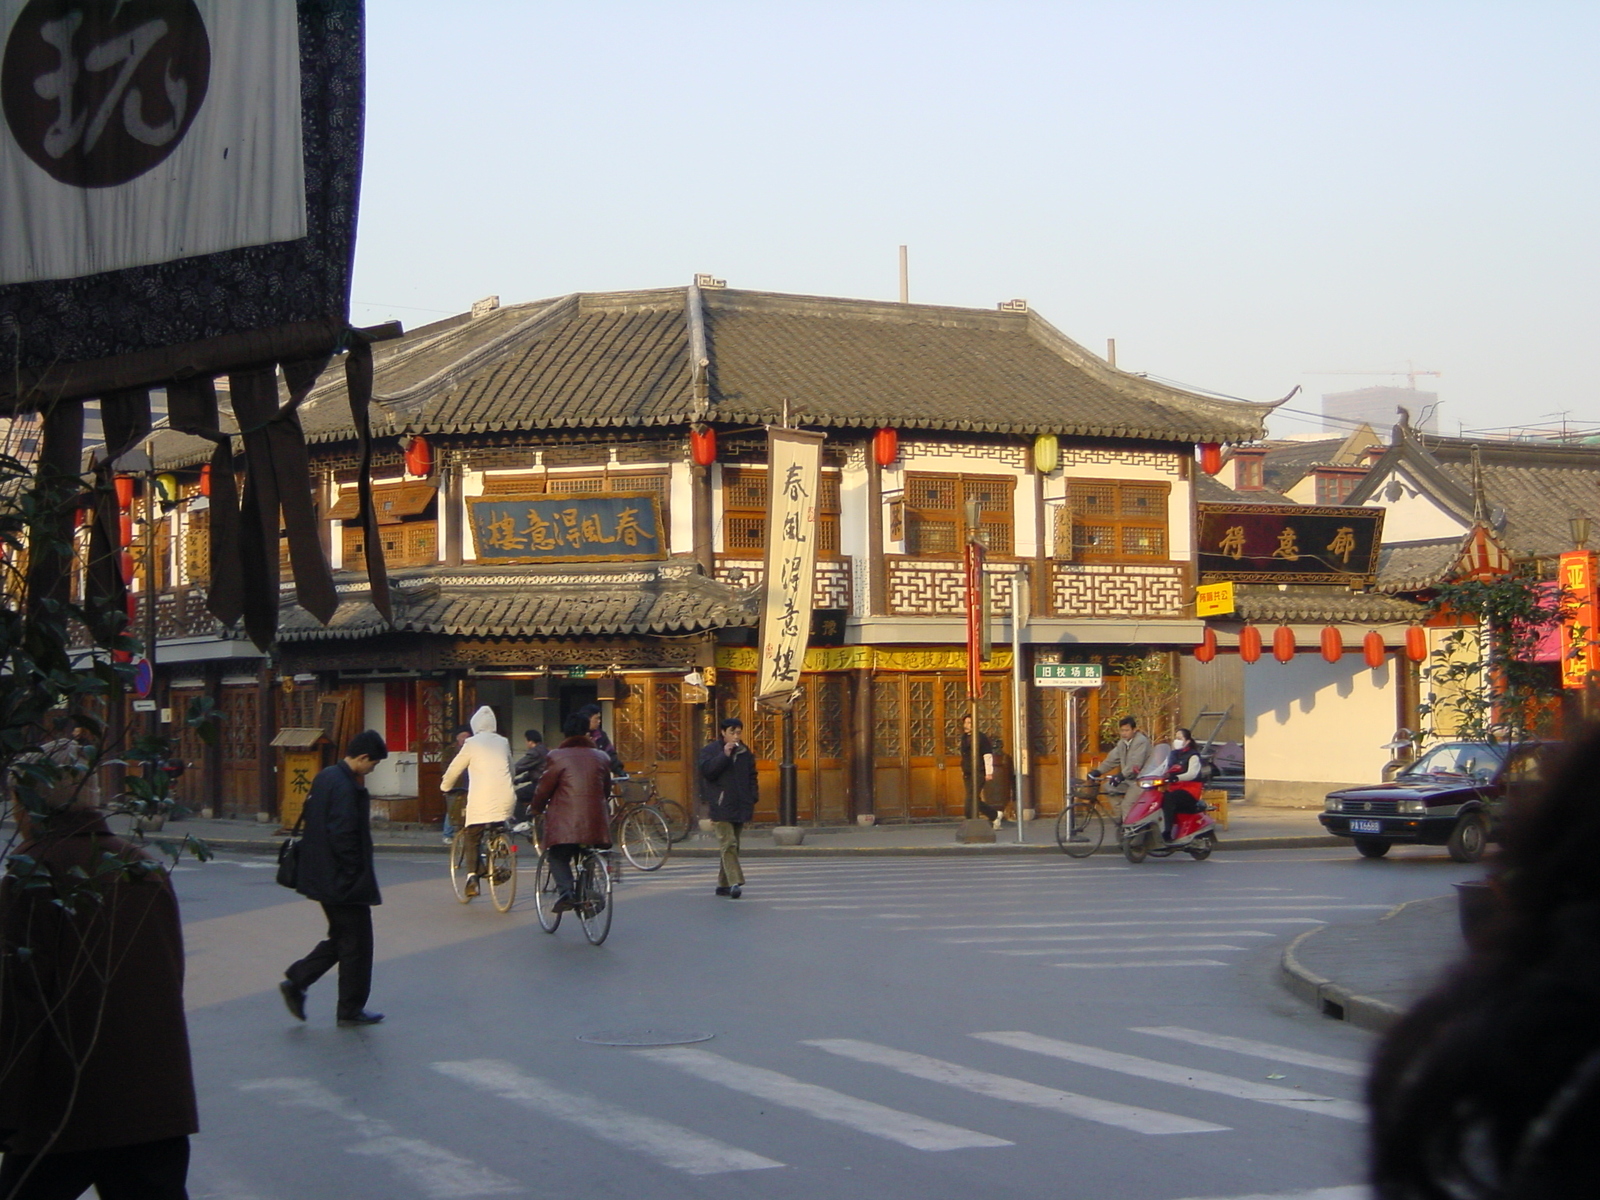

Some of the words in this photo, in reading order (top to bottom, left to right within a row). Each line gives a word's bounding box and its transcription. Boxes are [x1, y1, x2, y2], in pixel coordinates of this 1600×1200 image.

[1219, 526, 1356, 563] 得意廊
[1042, 666, 1095, 677] 旧校场路
[290, 767, 312, 795] 茶
